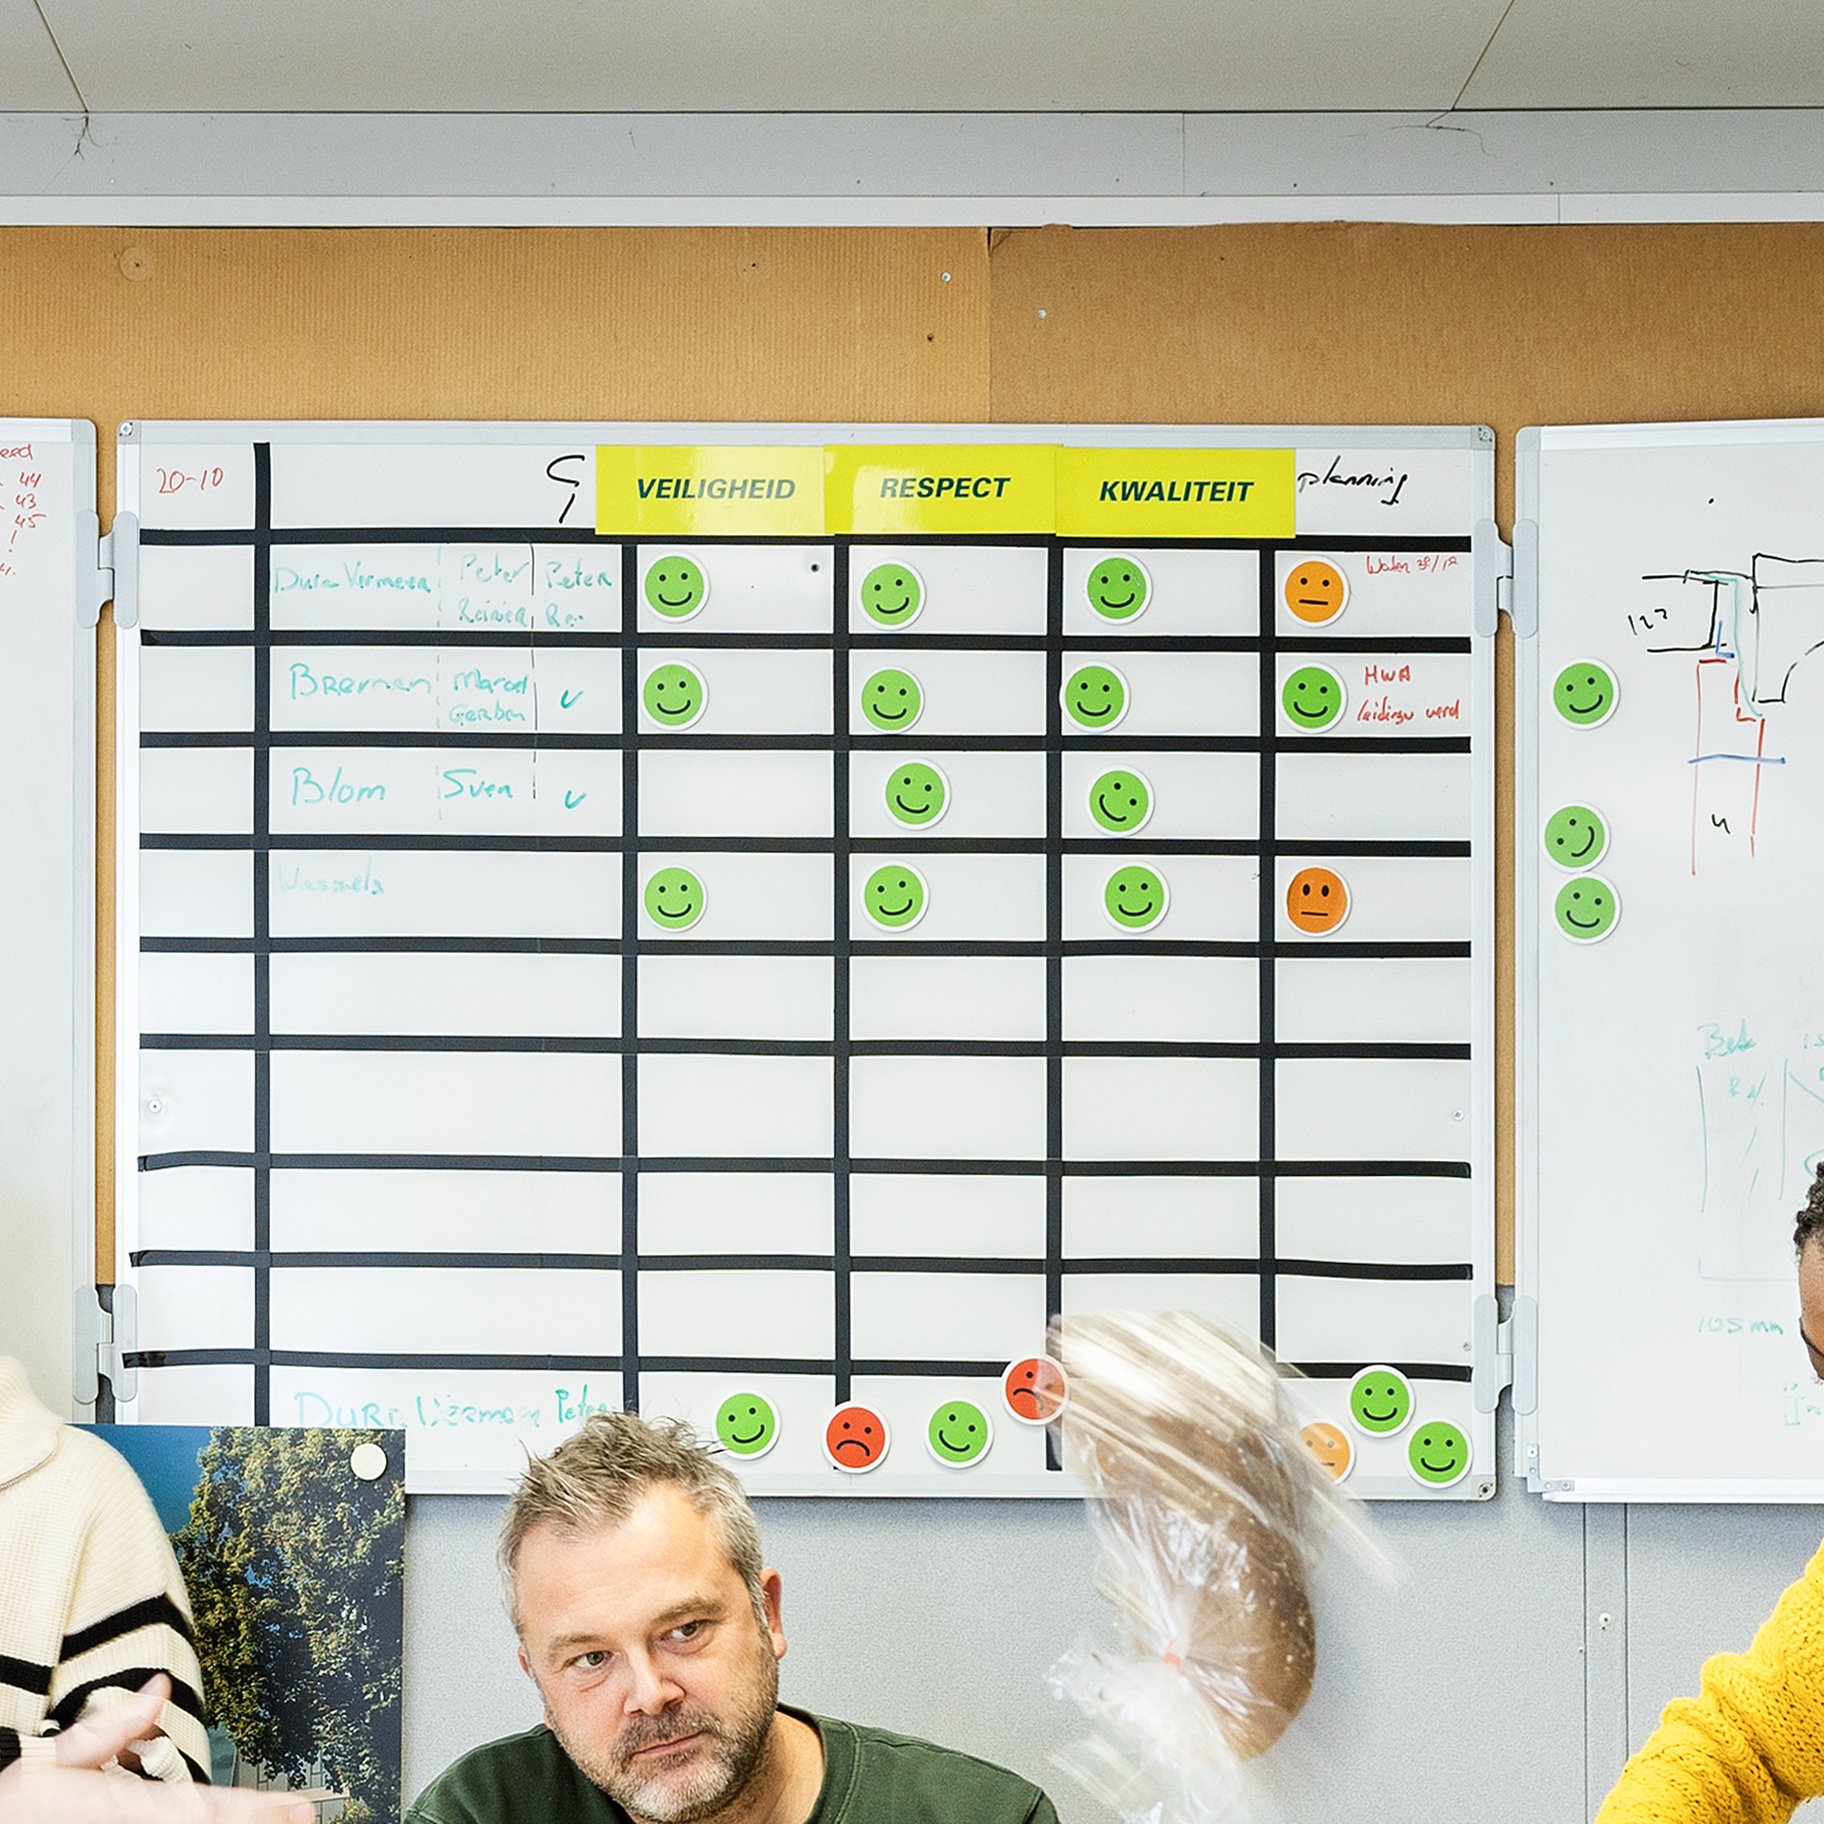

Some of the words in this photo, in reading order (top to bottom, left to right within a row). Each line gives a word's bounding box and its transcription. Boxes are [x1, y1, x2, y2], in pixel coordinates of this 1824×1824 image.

[157, 468, 223, 493] 20-10
[635, 478, 796, 500] VEILIGHEID
[880, 477, 1011, 498] RESPECT
[1099, 480, 1254, 502] KWALITEIT
[16, 494, 36, 509] 43
[292, 767, 385, 806] Blom
